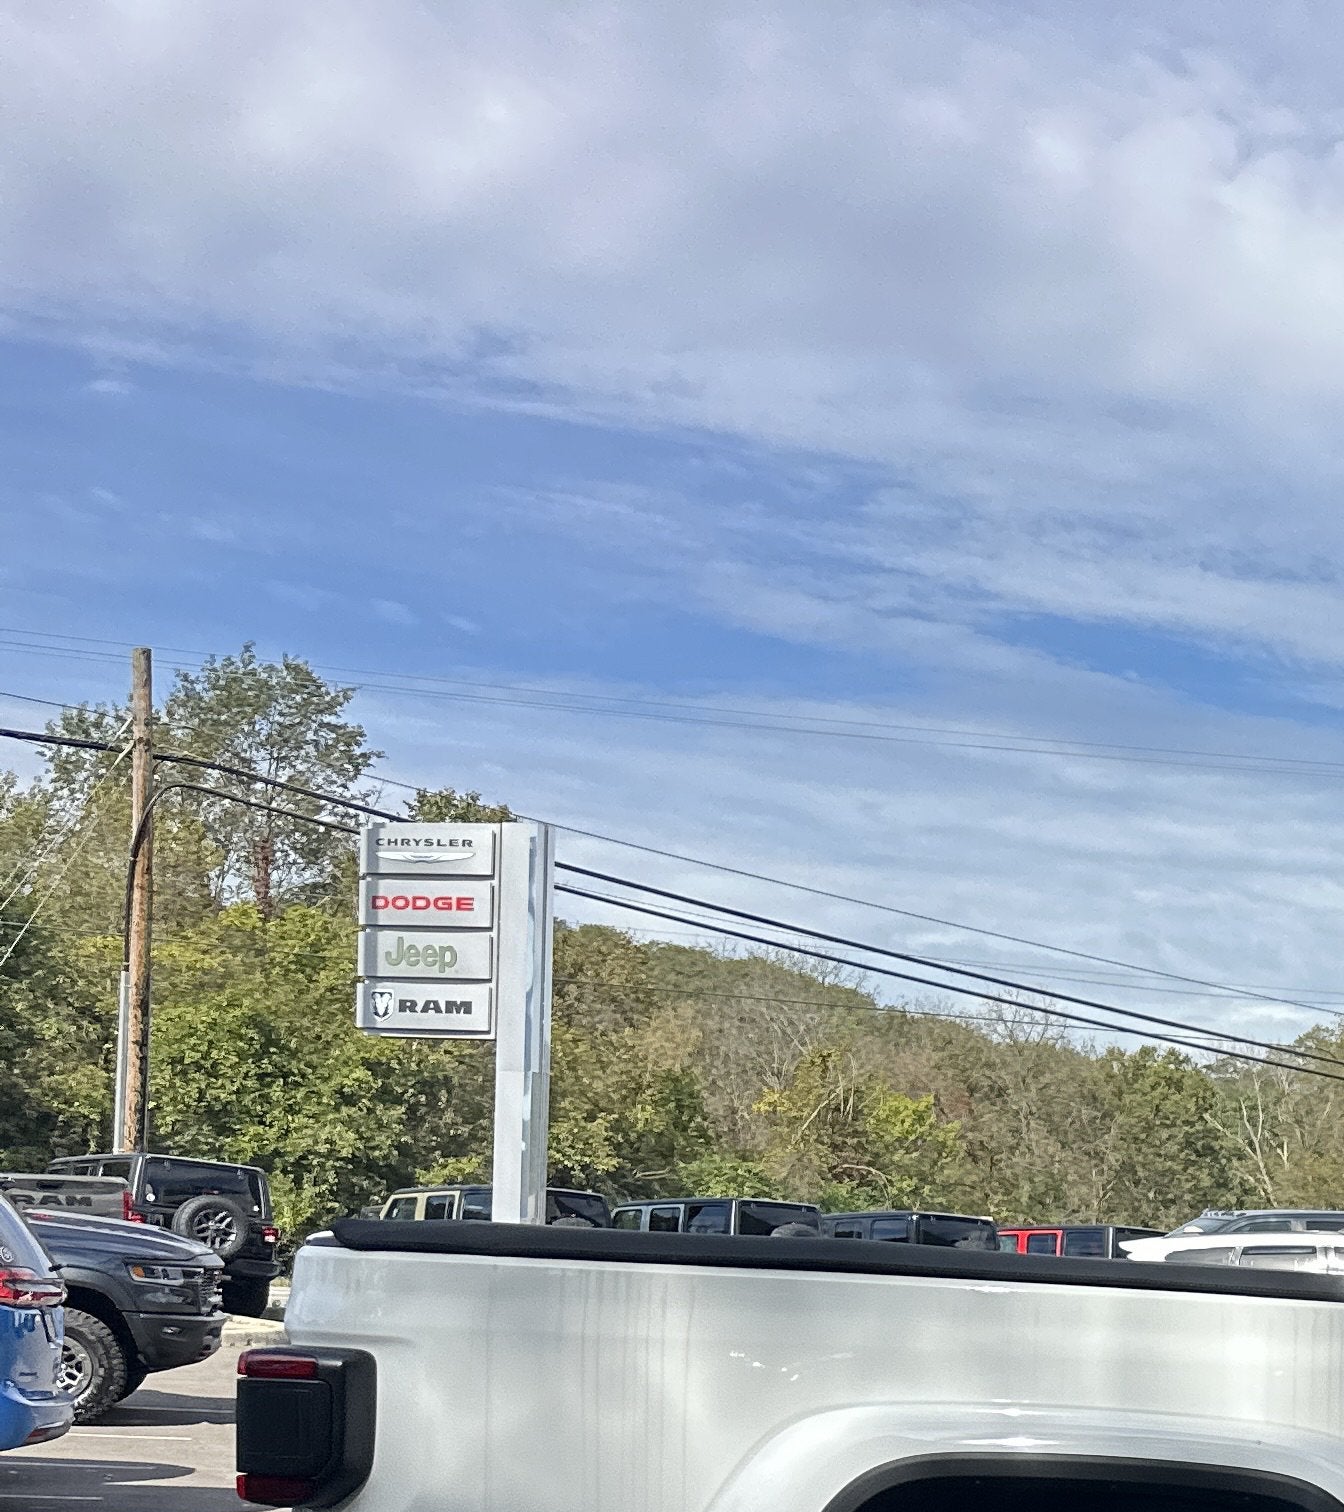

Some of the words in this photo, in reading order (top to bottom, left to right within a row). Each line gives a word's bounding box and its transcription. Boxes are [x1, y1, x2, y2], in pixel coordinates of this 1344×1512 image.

[375, 837, 473, 848] CHRYSLER
[371, 895, 475, 911] DODGE
[384, 936, 458, 973] Jeep
[398, 999, 473, 1015] RAM
[9, 1194, 92, 1207] RAM
